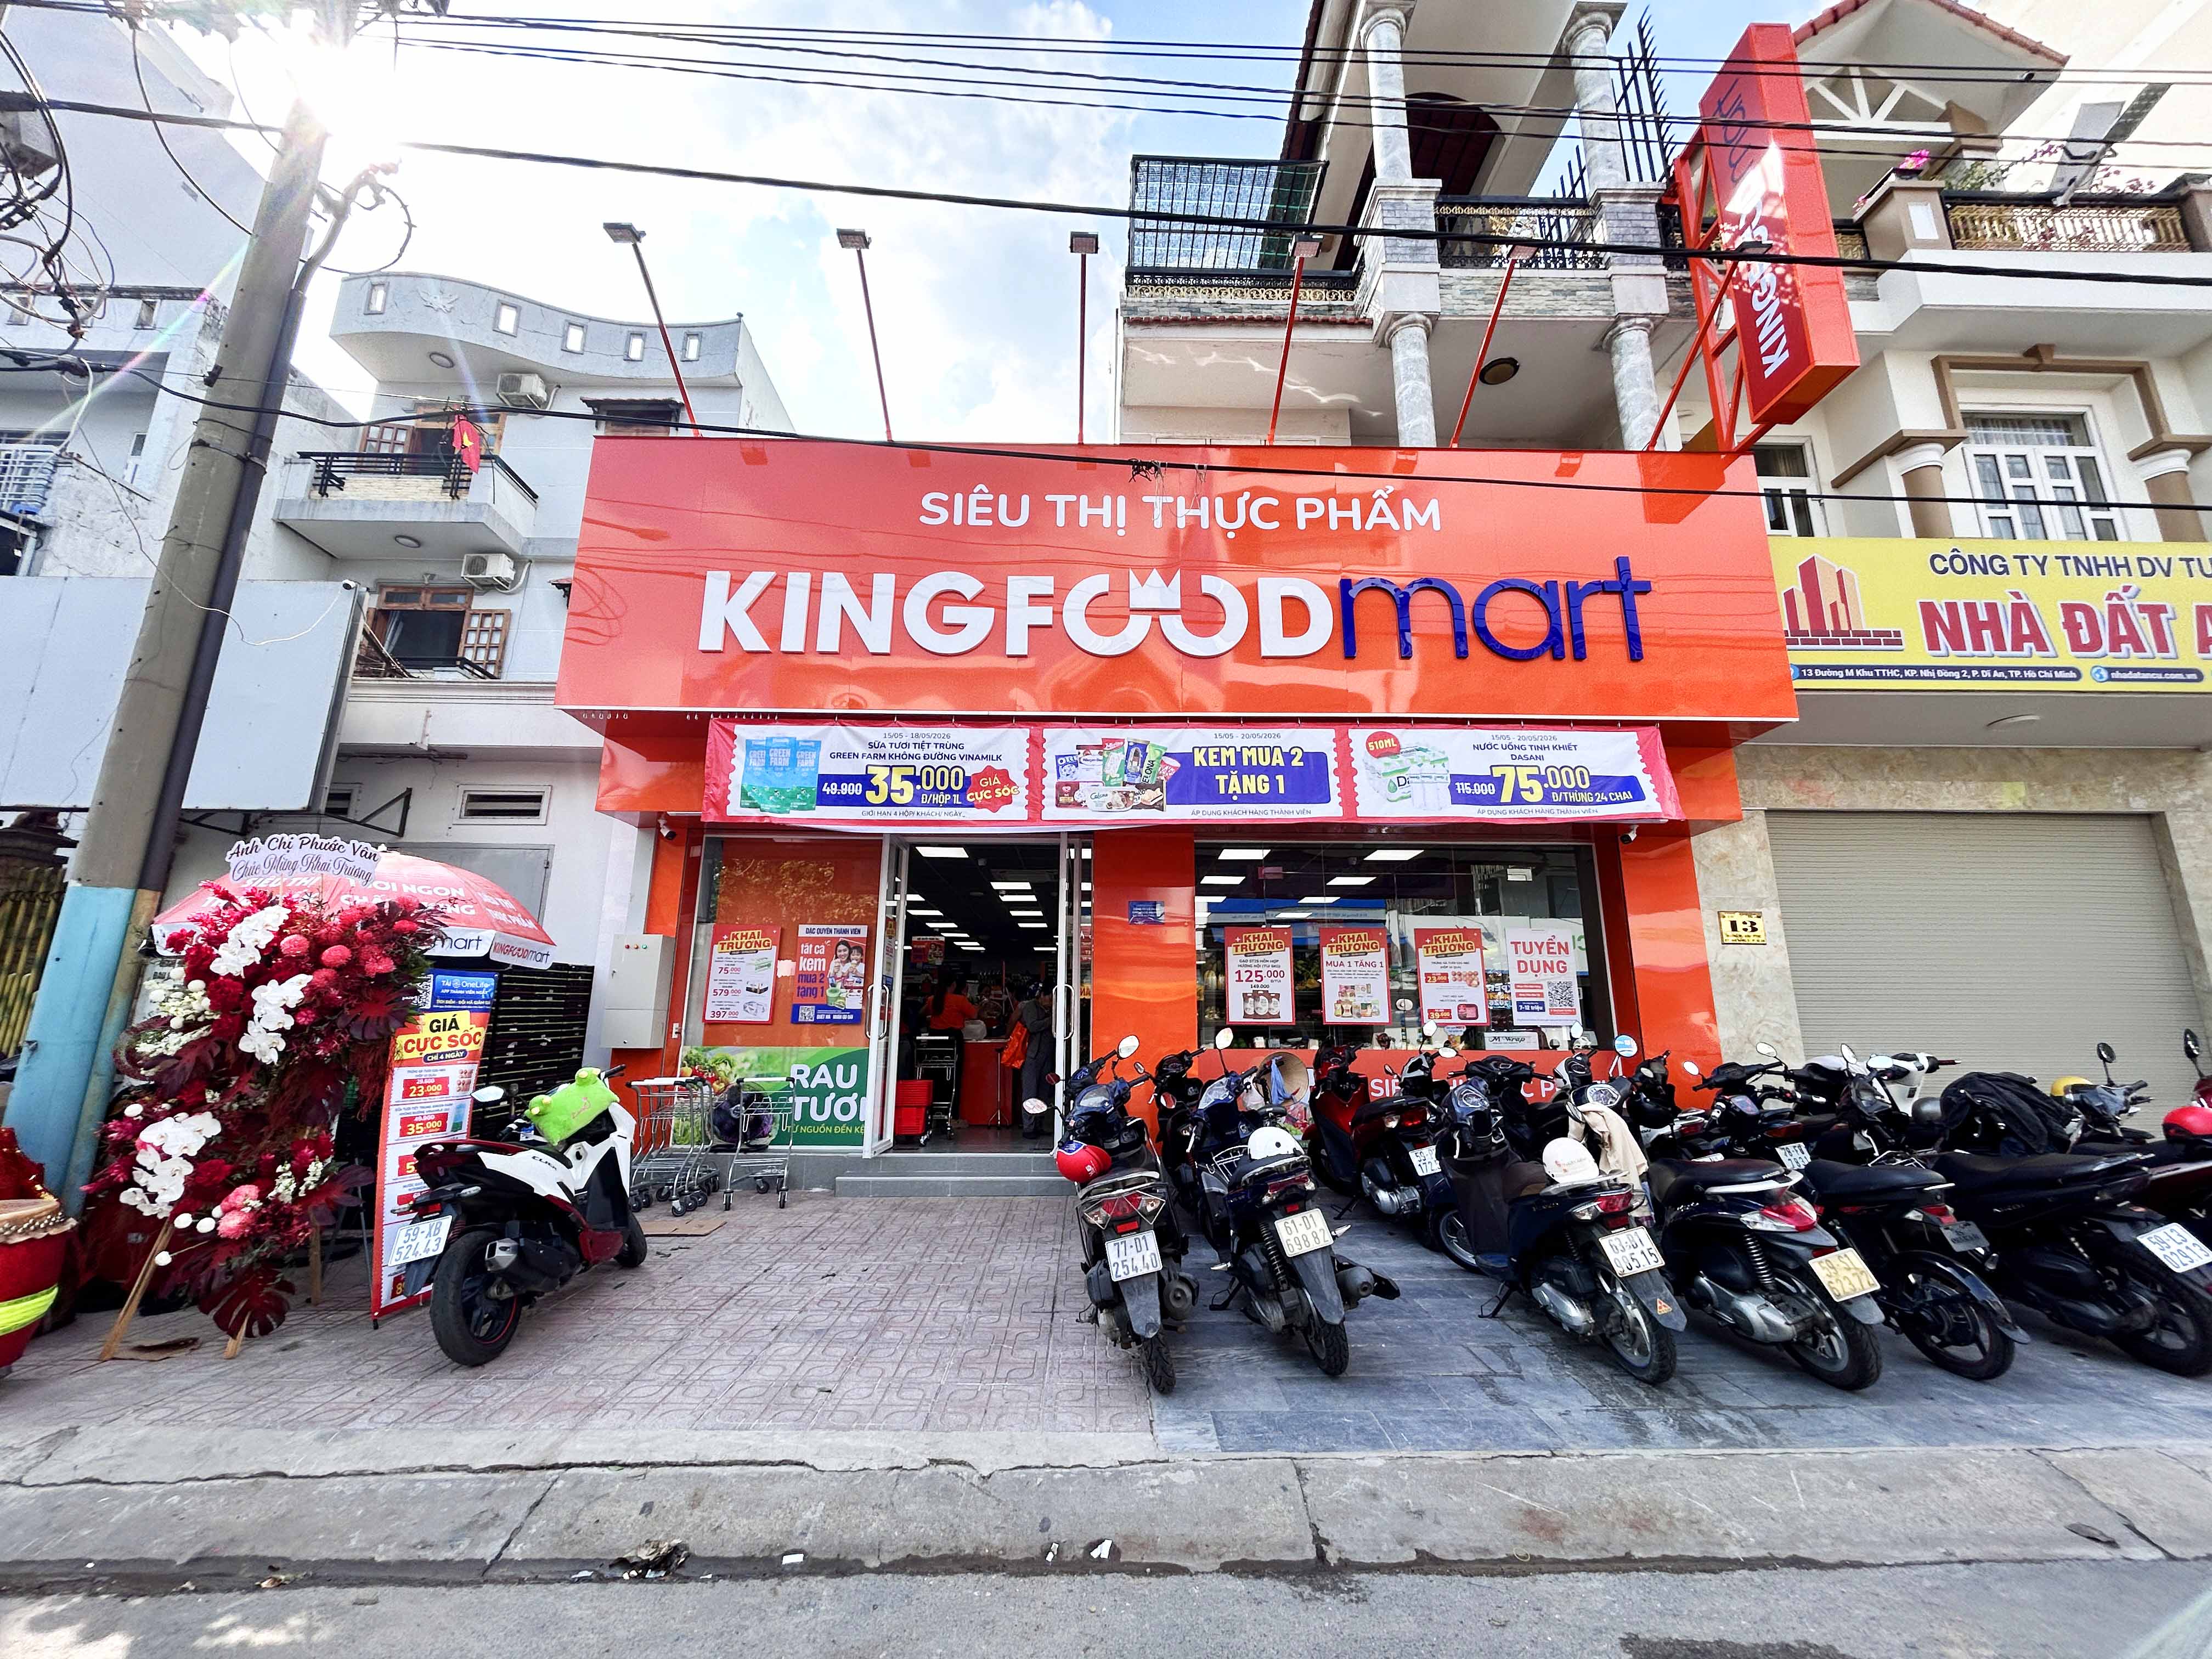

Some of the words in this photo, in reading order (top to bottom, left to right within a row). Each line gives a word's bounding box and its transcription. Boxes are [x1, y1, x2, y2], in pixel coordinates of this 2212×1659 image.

[919, 490, 1030, 528] SIÊU
[1045, 495, 1126, 537] THỊ
[1143, 490, 1280, 538] THỰC
[1297, 487, 1442, 533] PHẨM
[1929, 548, 2010, 576] CÔNG
[2014, 555, 2048, 576] TY
[2055, 555, 2132, 577] TNHH
[2137, 557, 2172, 578] DV
[1918, 590, 2057, 658] NHÀ
[2059, 584, 2179, 659] ĐẤT
[1815, 669, 1843, 678] Đường
[1874, 669, 1903, 678] TTHC,
[1920, 669, 1936, 679] Nhị
[1961, 670, 1971, 679] 2,
[1993, 671, 2007, 679] An,
[868, 741, 886, 749] SỮA
[912, 742, 932, 751] TIỆT
[934, 741, 964, 750] TRÙNG
[1368, 738, 1397, 751] 510ML
[1473, 742, 1499, 751] NƯỚC
[1502, 741, 1527, 751] UỐNG
[1553, 742, 1578, 751] KHIẾT
[769, 748, 791, 757] GREEN
[889, 751, 921, 760] KHÔNG
[923, 752, 956, 760] ĐƯỜNG
[1193, 747, 1235, 766] KEM
[1242, 747, 1285, 766] MUA
[1290, 747, 1304, 766] 2
[770, 757, 789, 766] FARM
[979, 773, 1001, 787] GIÁ
[1215, 770, 1269, 801] TẶNG
[1276, 774, 1285, 794] 1
[966, 789, 994, 804] CỰC
[995, 783, 1019, 795] SỐC
[1595, 792, 1607, 802] 24
[1609, 791, 1633, 800] CHAI
[921, 794, 950, 807] Đ/HỘP
[953, 794, 962, 804] 1L
[229, 840, 261, 859] Anh
[268, 837, 294, 853] Chị
[300, 836, 346, 853] Phước
[352, 843, 379, 862] Vân
[232, 859, 261, 882] Chúc
[301, 853, 331, 874] Khai
[403, 884, 465, 896] NGON
[1729, 921, 1758, 933] 13
[731, 930, 760, 940] KHAI
[1244, 933, 1272, 943] KHAI
[1339, 933, 1368, 944] KHAI
[1434, 934, 1462, 944] KHAI
[719, 939, 771, 950] TRƯƠNG
[1233, 941, 1284, 953] TRƯƠNG
[1328, 942, 1380, 954] TRƯƠNG
[1423, 943, 1474, 954] TRƯƠNG
[1510, 935, 1570, 955] TUYỂN
[799, 956, 826, 971] kem
[1516, 960, 1568, 977] DỤNG
[798, 973, 816, 983] mua
[819, 973, 825, 983] 2
[1235, 970, 1285, 983] 125.000
[820, 986, 824, 997] 1
[429, 1014, 460, 1033] GIÁ
[404, 1037, 442, 1055] CỰC
[448, 1027, 482, 1048] SỐC
[445, 1051, 464, 1059] NGÀY
[789, 1064, 857, 1088] RAU
[409, 1085, 442, 1097] 23.000
[407, 1120, 442, 1135] 35.000
[834, 1124, 852, 1133] ĐẾN
[1415, 1148, 1434, 1162] 59-P
[394, 1238, 442, 1262] 524.43
